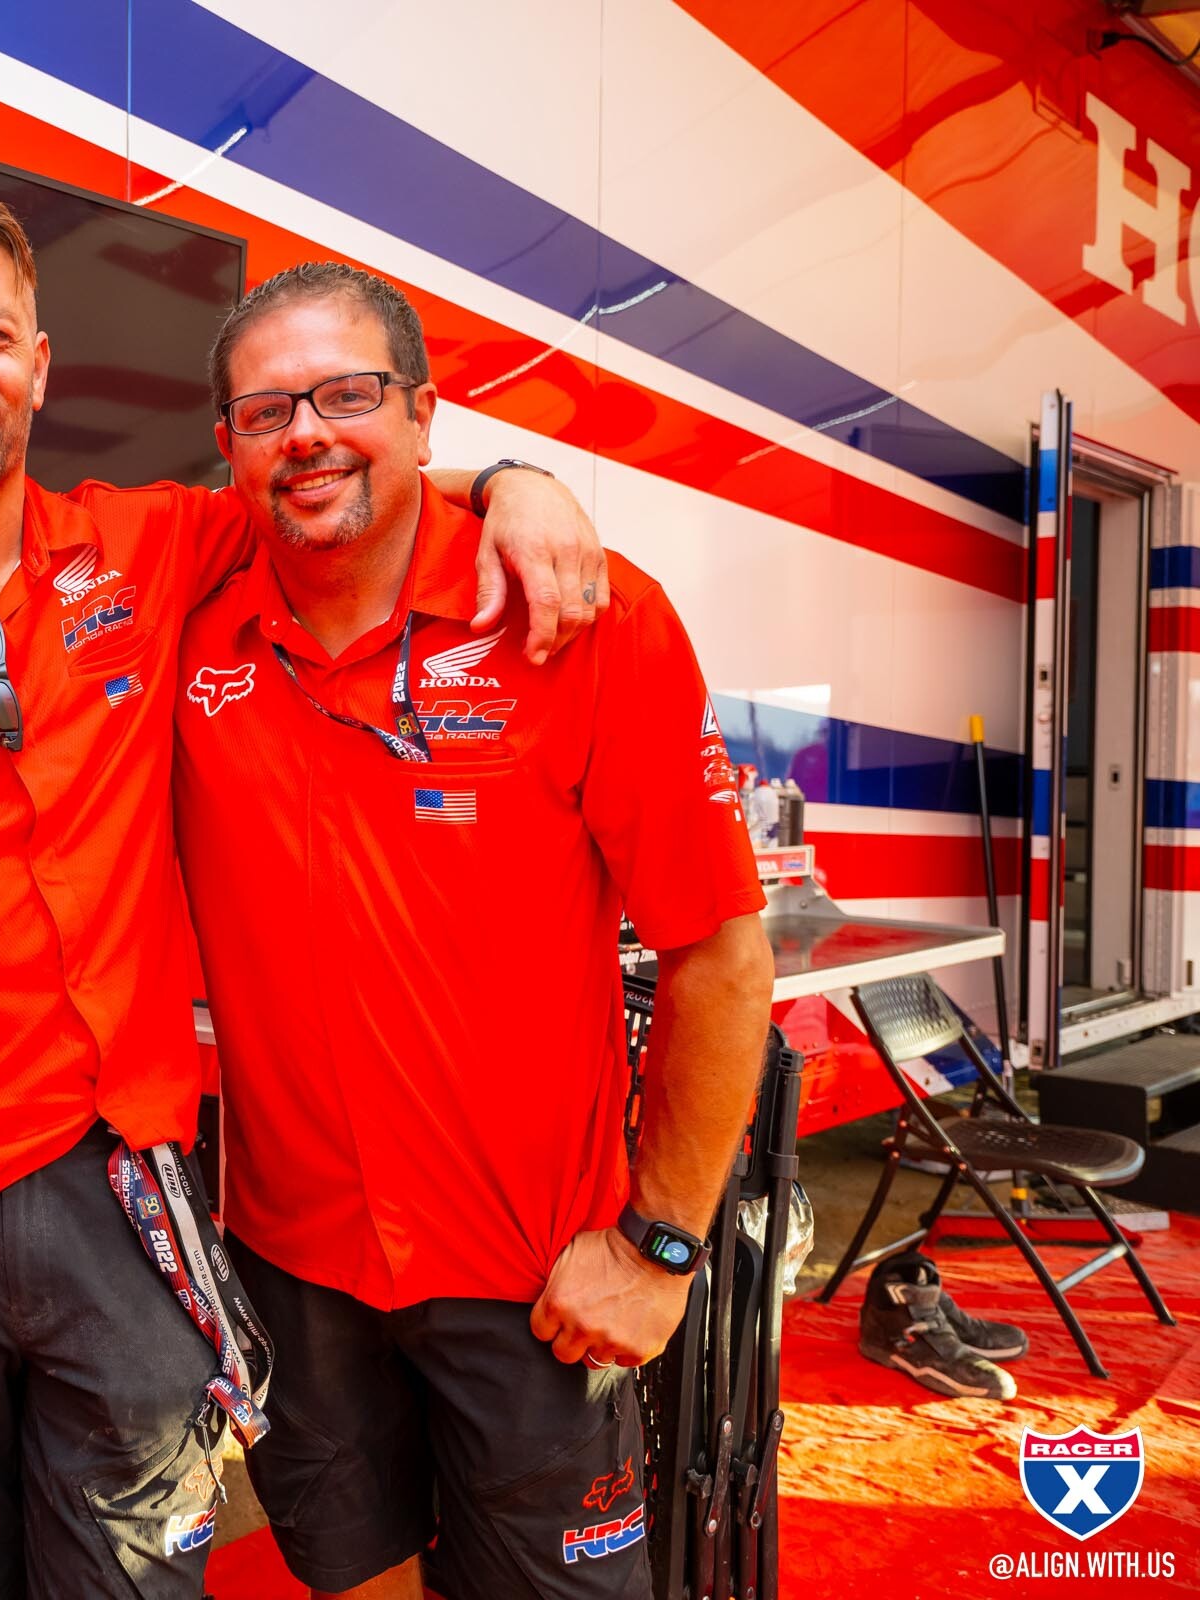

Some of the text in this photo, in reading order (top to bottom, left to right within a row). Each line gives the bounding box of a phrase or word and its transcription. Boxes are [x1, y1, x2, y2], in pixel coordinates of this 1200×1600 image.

[60, 570, 123, 607] HONDA
[62, 585, 136, 650] HRC
[67, 619, 133, 653] Honda RACING
[392, 661, 406, 703] 2022
[419, 676, 501, 688] HONDA
[146, 1196, 160, 1214] 50
[149, 1230, 178, 1273] 2022
[165, 1500, 217, 1556] HRC
[563, 1504, 645, 1563] HRC
